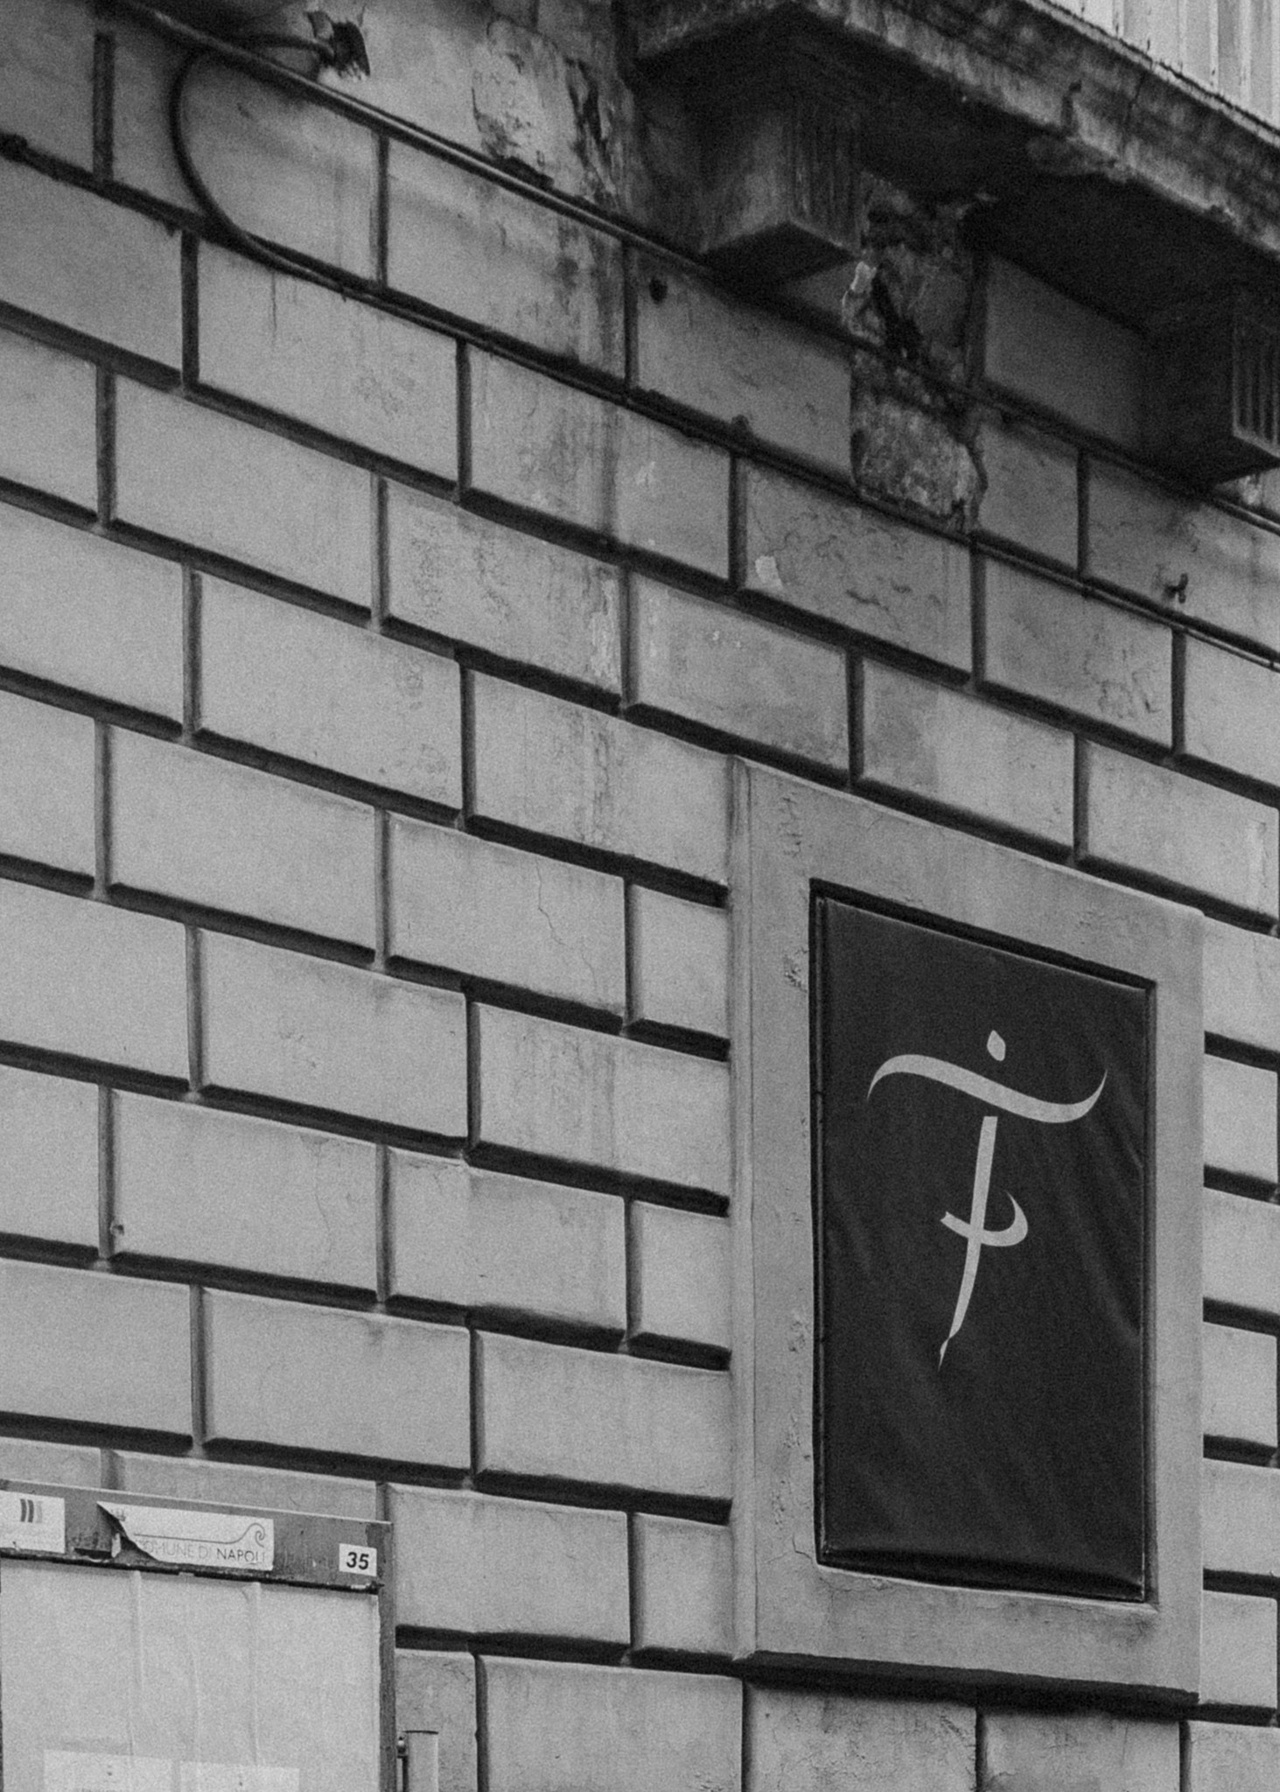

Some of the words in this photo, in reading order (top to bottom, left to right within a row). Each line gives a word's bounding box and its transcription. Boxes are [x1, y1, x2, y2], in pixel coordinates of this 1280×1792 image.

[140, 1540, 195, 1559] OMUNE
[216, 1547, 266, 1563] NAPOLI
[346, 1551, 369, 1570] 35
